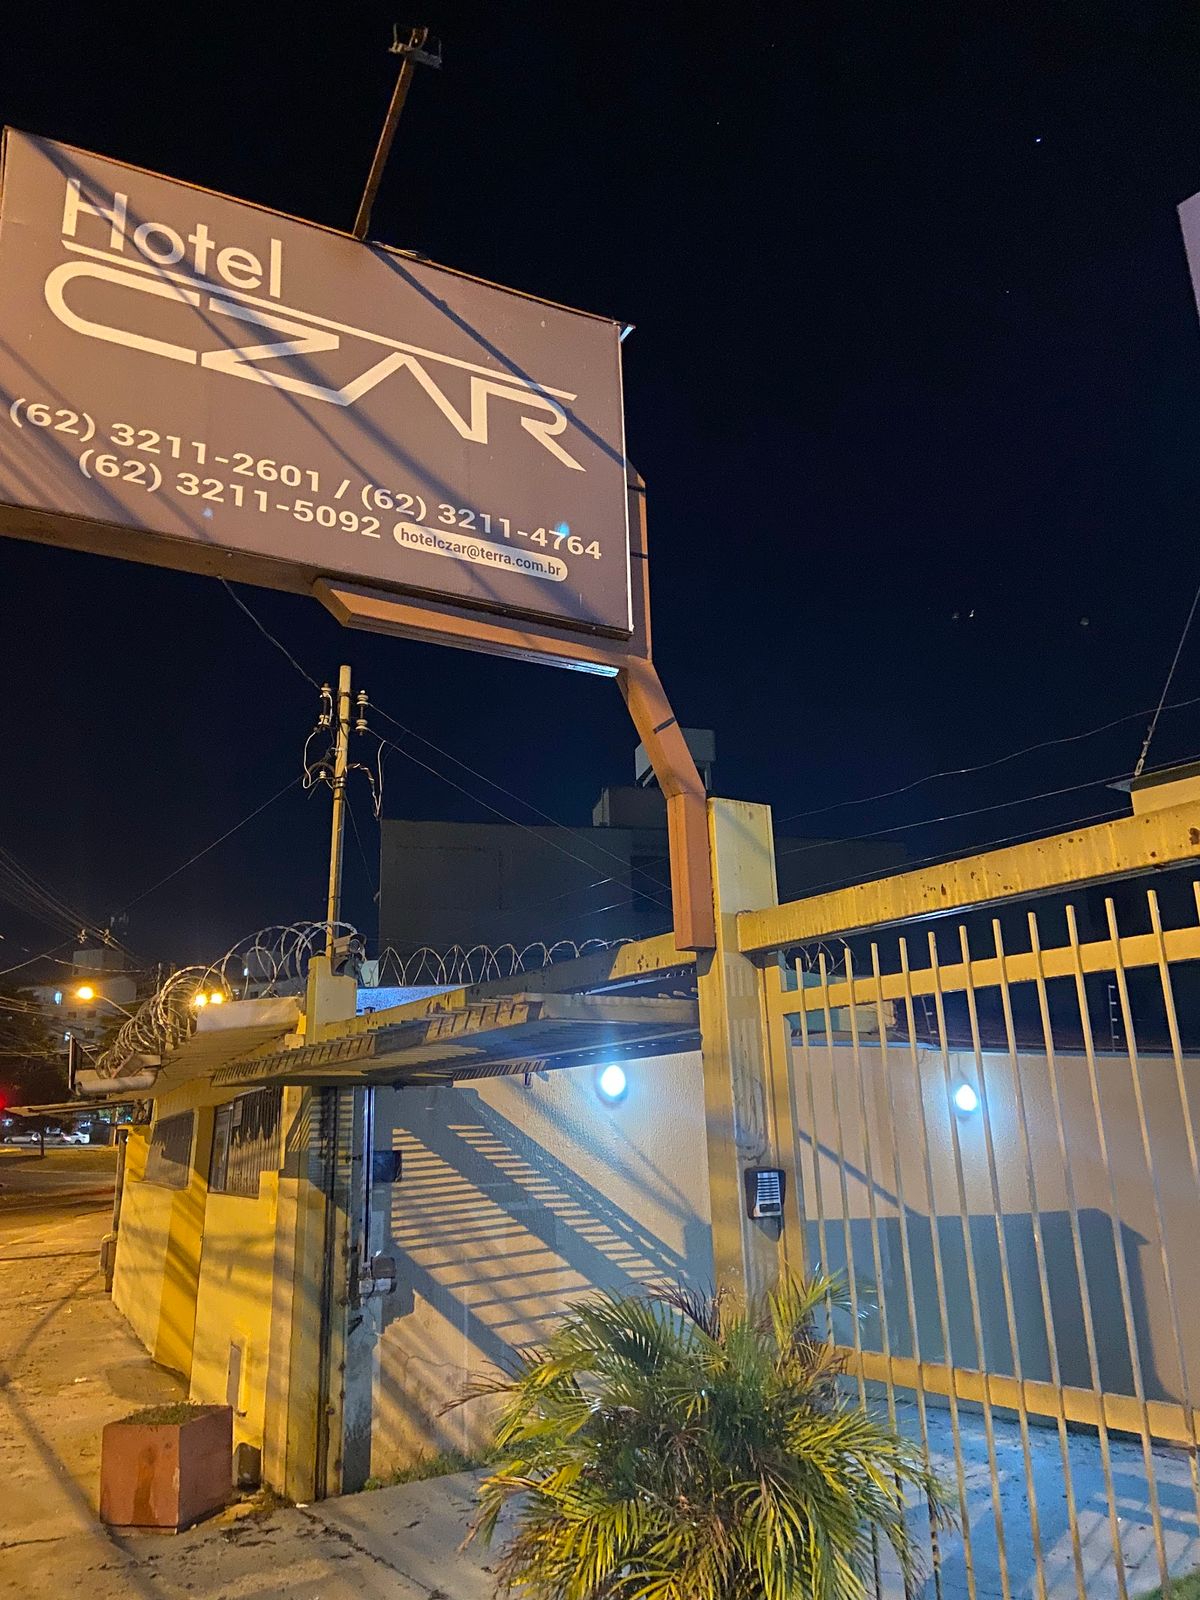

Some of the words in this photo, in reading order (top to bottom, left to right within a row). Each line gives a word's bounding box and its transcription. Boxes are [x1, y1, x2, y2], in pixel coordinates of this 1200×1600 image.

[61, 178, 282, 299] Hotel
[44, 260, 587, 472] CZAR
[9, 398, 96, 442] (62)
[110, 423, 321, 492] 3211-2601
[334, 478, 351, 499] /
[360, 483, 428, 522] (62)
[437, 503, 603, 560] 3211-4764
[78, 449, 163, 492] (62)
[176, 472, 382, 539] 3211-5092
[400, 528, 562, 577] hotelczar@terra.com.br
